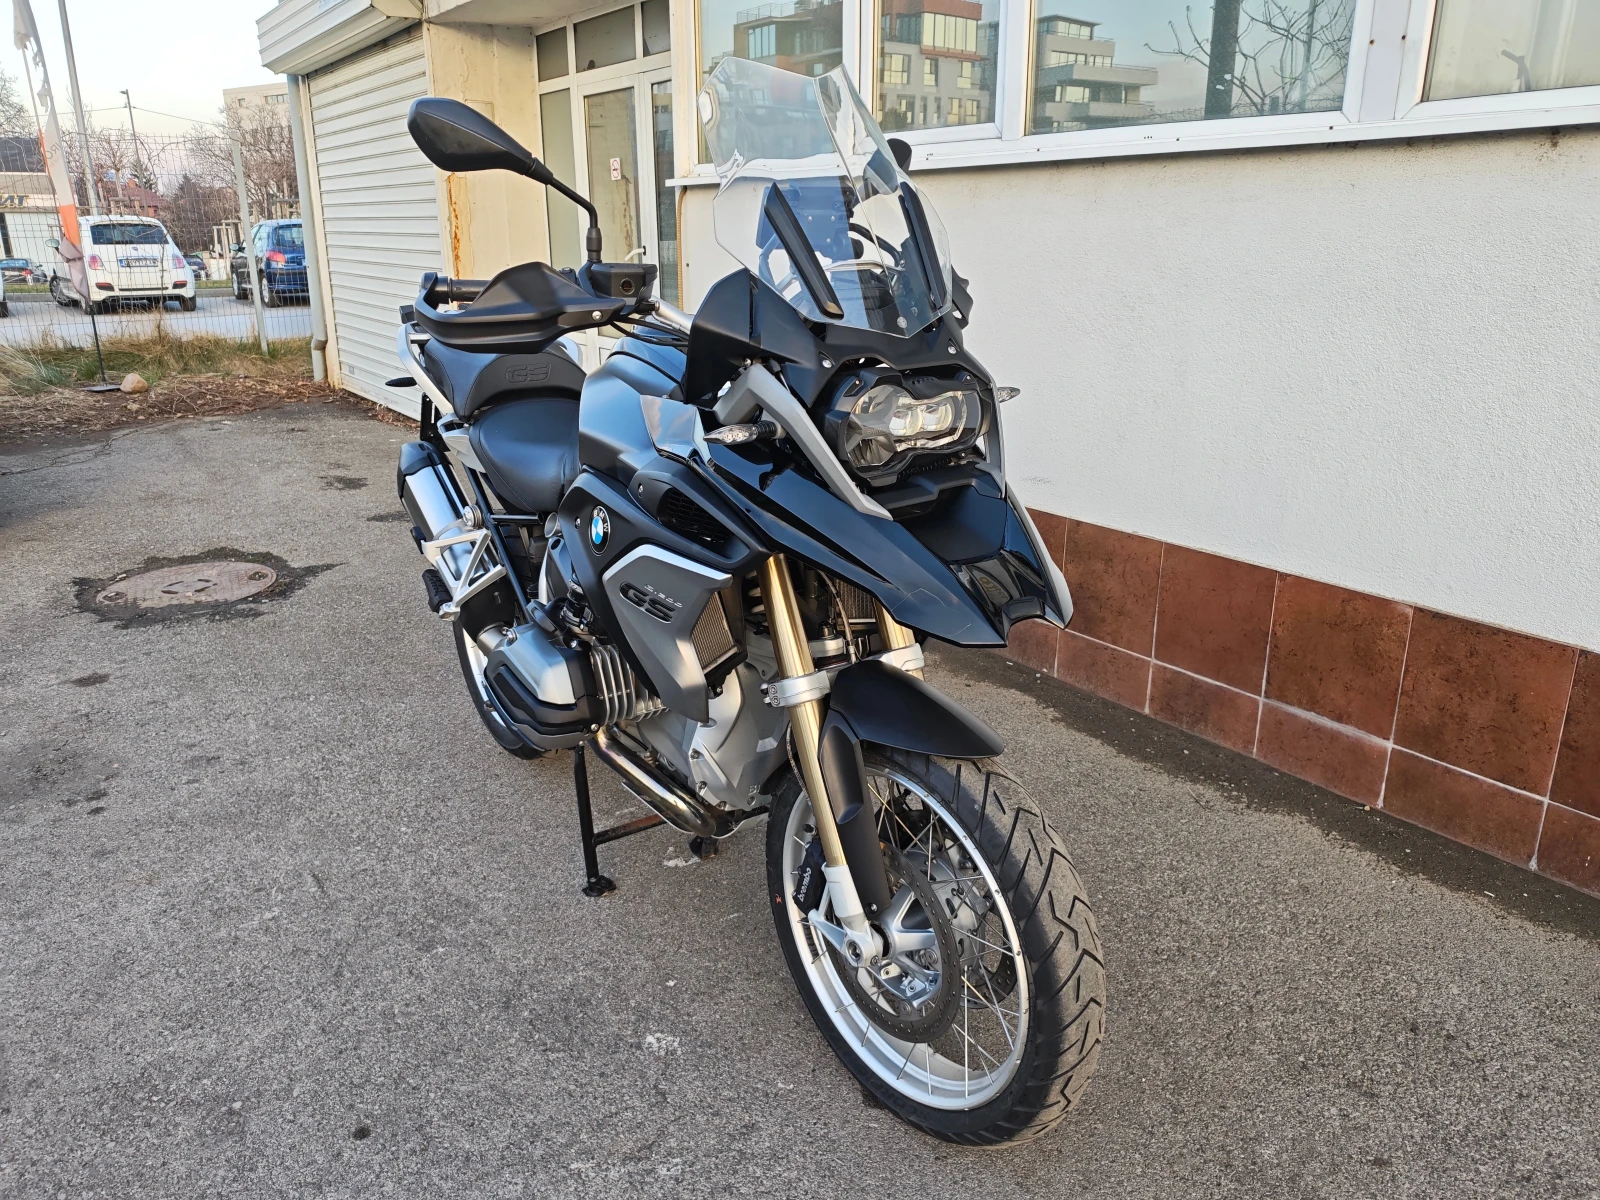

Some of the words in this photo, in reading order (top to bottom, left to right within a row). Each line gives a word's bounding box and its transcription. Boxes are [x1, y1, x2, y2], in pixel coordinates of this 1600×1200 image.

[505, 360, 551, 383] GS
[592, 508, 609, 532] BMW
[619, 581, 676, 624] GS
[797, 867, 812, 903] brembo
